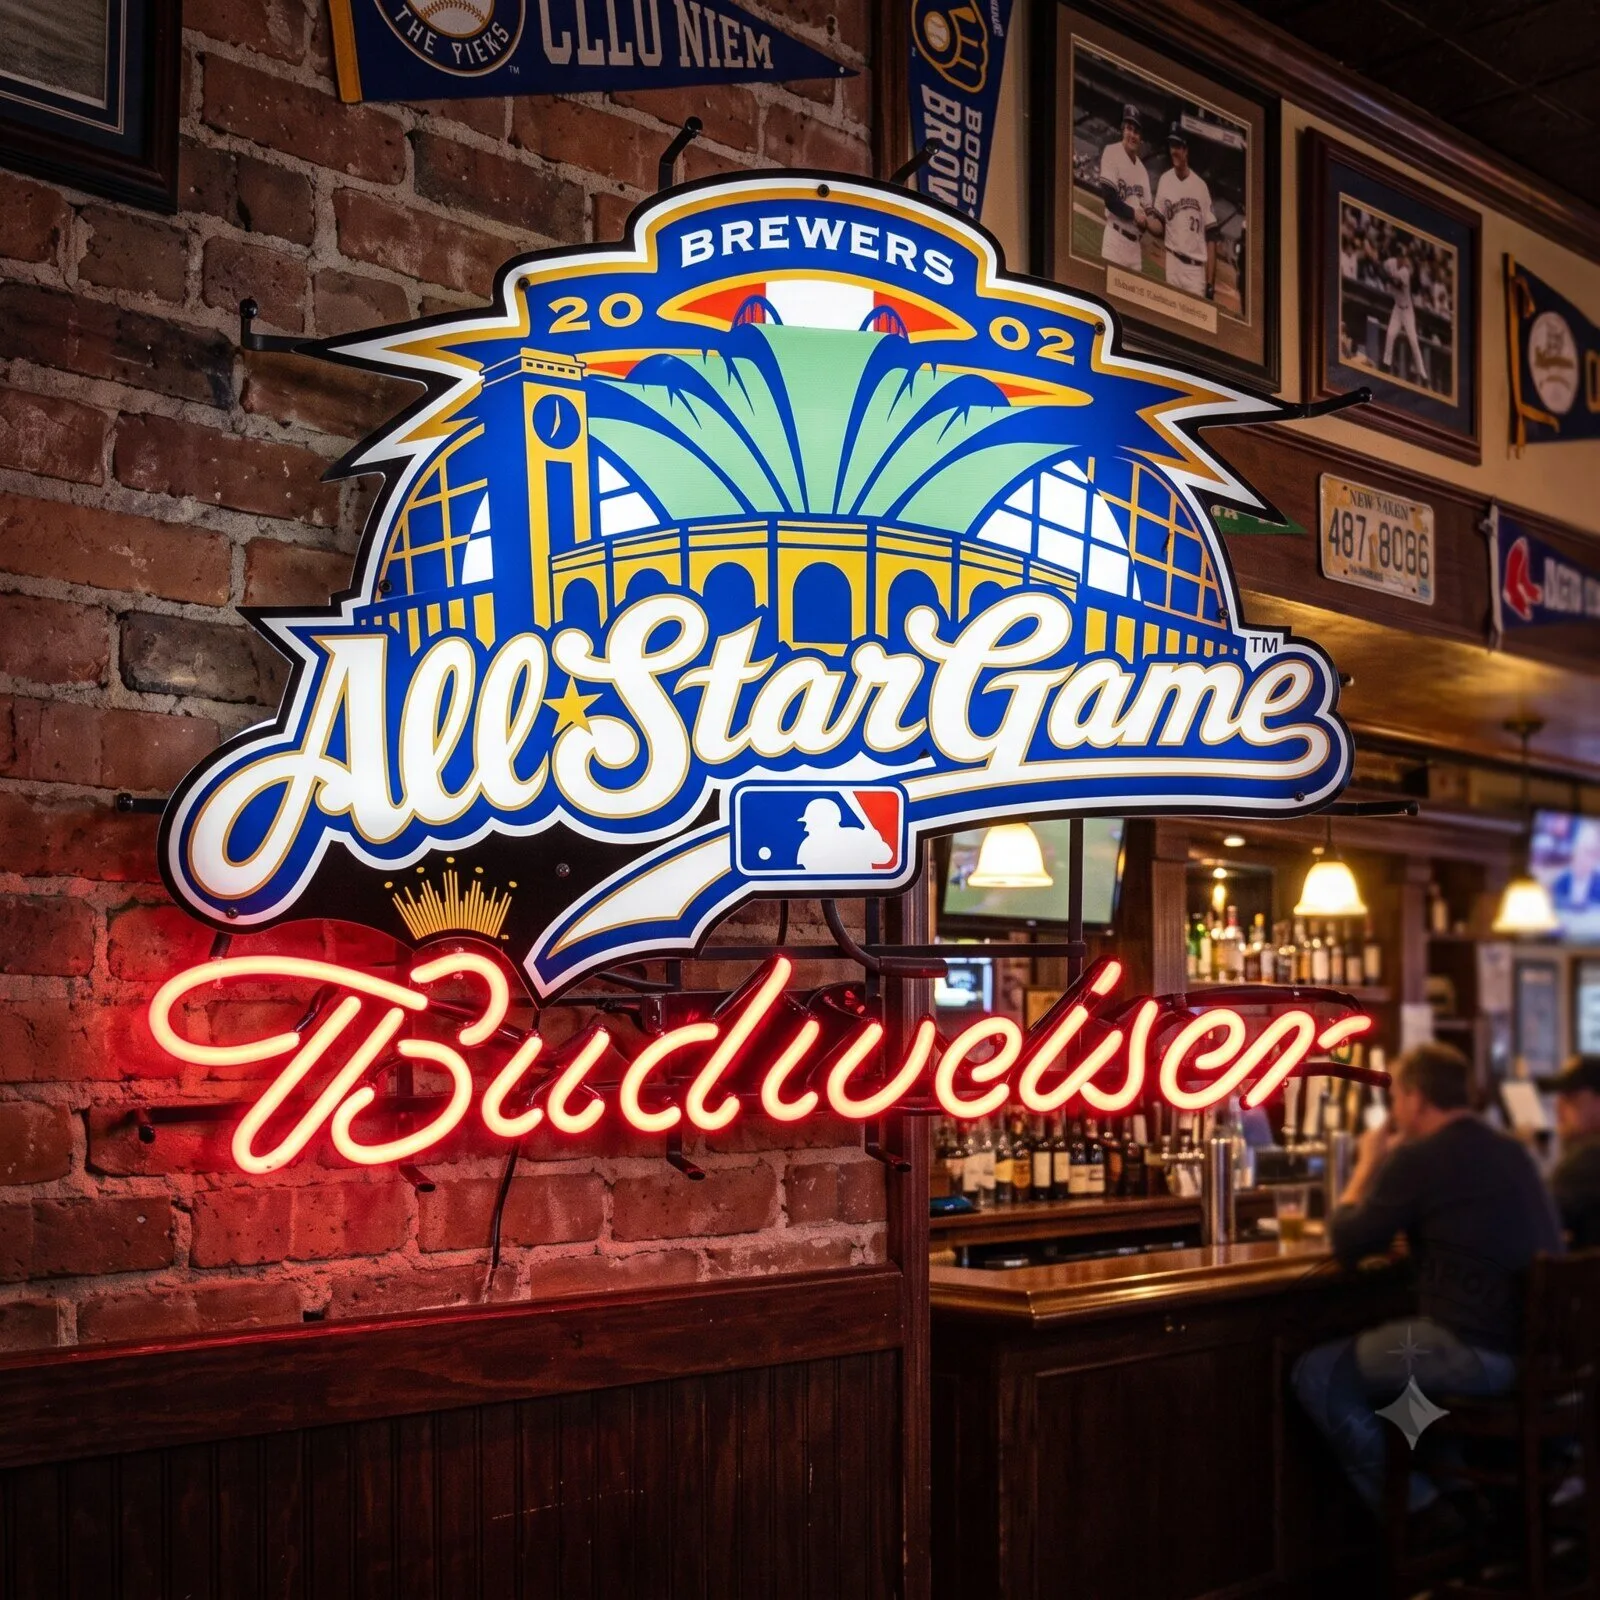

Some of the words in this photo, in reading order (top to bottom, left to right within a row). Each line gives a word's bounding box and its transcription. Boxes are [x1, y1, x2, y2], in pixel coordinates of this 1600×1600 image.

[394, 4, 438, 54] THE
[674, 0, 774, 69] NIEM
[508, 65, 520, 75] TM
[680, 216, 955, 286] BREWERS
[547, 292, 644, 334] 20
[988, 315, 1076, 366] 02
[1328, 507, 1366, 562] 487
[1378, 522, 1430, 580] 8086
[1249, 636, 1278, 653] TM
[148, 952, 1373, 1176] Budweiser
